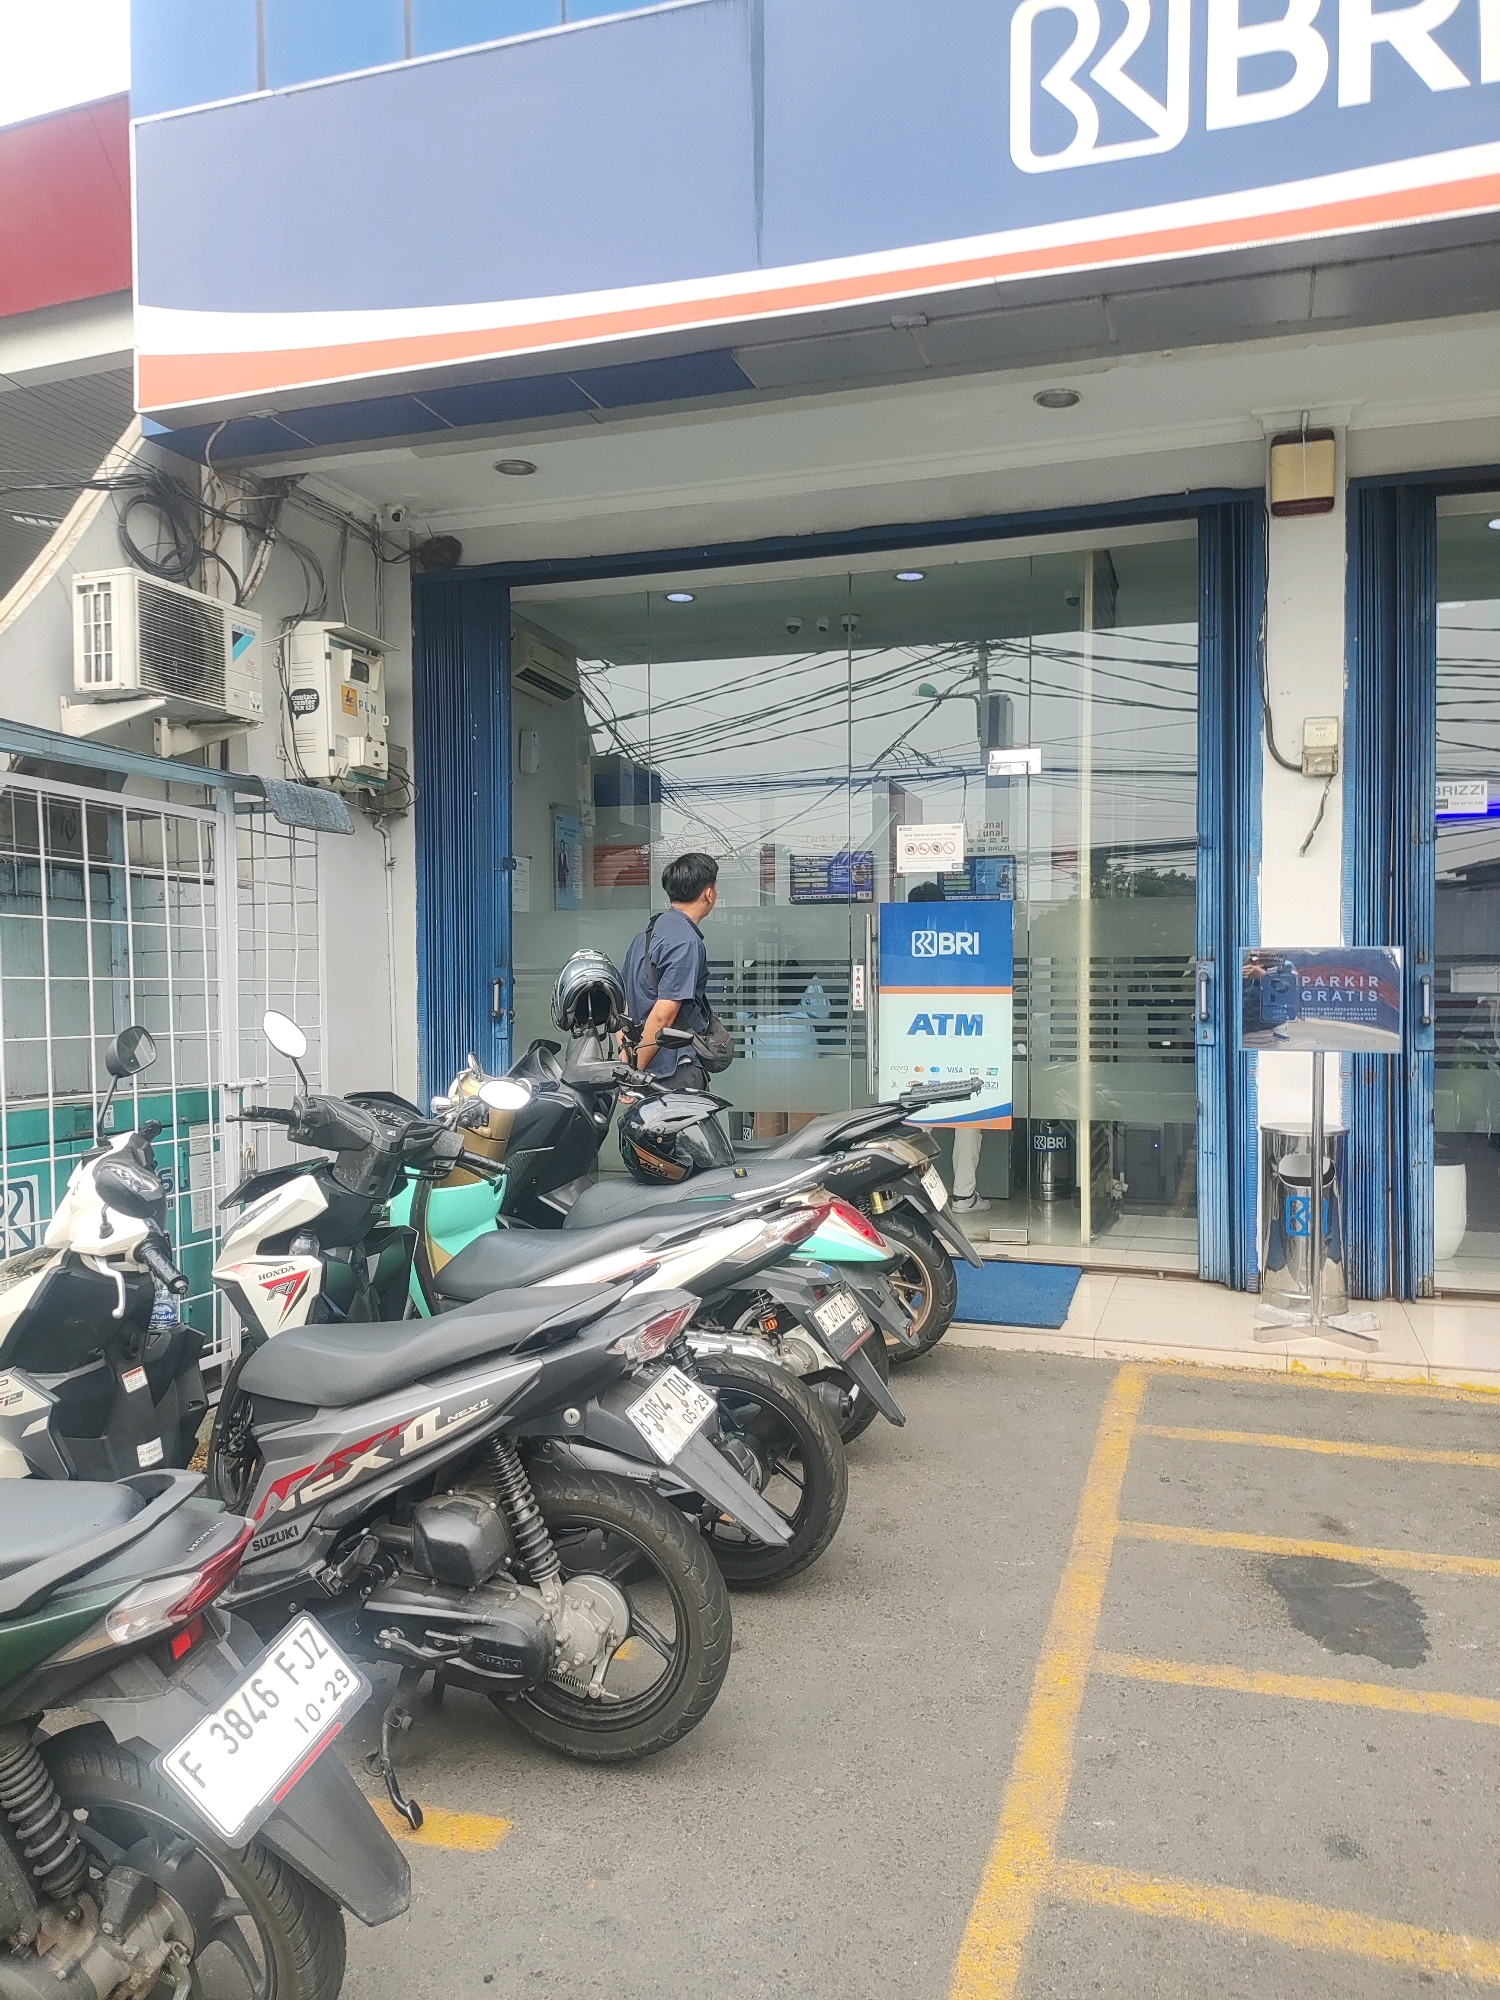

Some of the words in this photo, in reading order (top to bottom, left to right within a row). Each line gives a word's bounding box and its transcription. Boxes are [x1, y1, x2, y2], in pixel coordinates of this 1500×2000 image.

[291, 693, 317, 701] contact
[358, 699, 377, 715] PLN
[938, 931, 980, 955] BRI
[1301, 975, 1379, 987] PARKIR
[1301, 990, 1378, 1002] GRATIS
[906, 1013, 983, 1036] ATM
[1046, 1136, 1067, 1149] BRI
[258, 1265, 296, 1281] HONDA
[447, 1402, 481, 1423] NEX
[639, 1392, 673, 1426] 5054
[632, 1414, 652, 1436] B
[251, 1525, 300, 1552] SUZUKI
[476, 1651, 522, 1669] SUZUKI
[178, 1752, 208, 1789] F
[209, 1678, 281, 1756] 3846
[274, 1627, 329, 1685] FJZ
